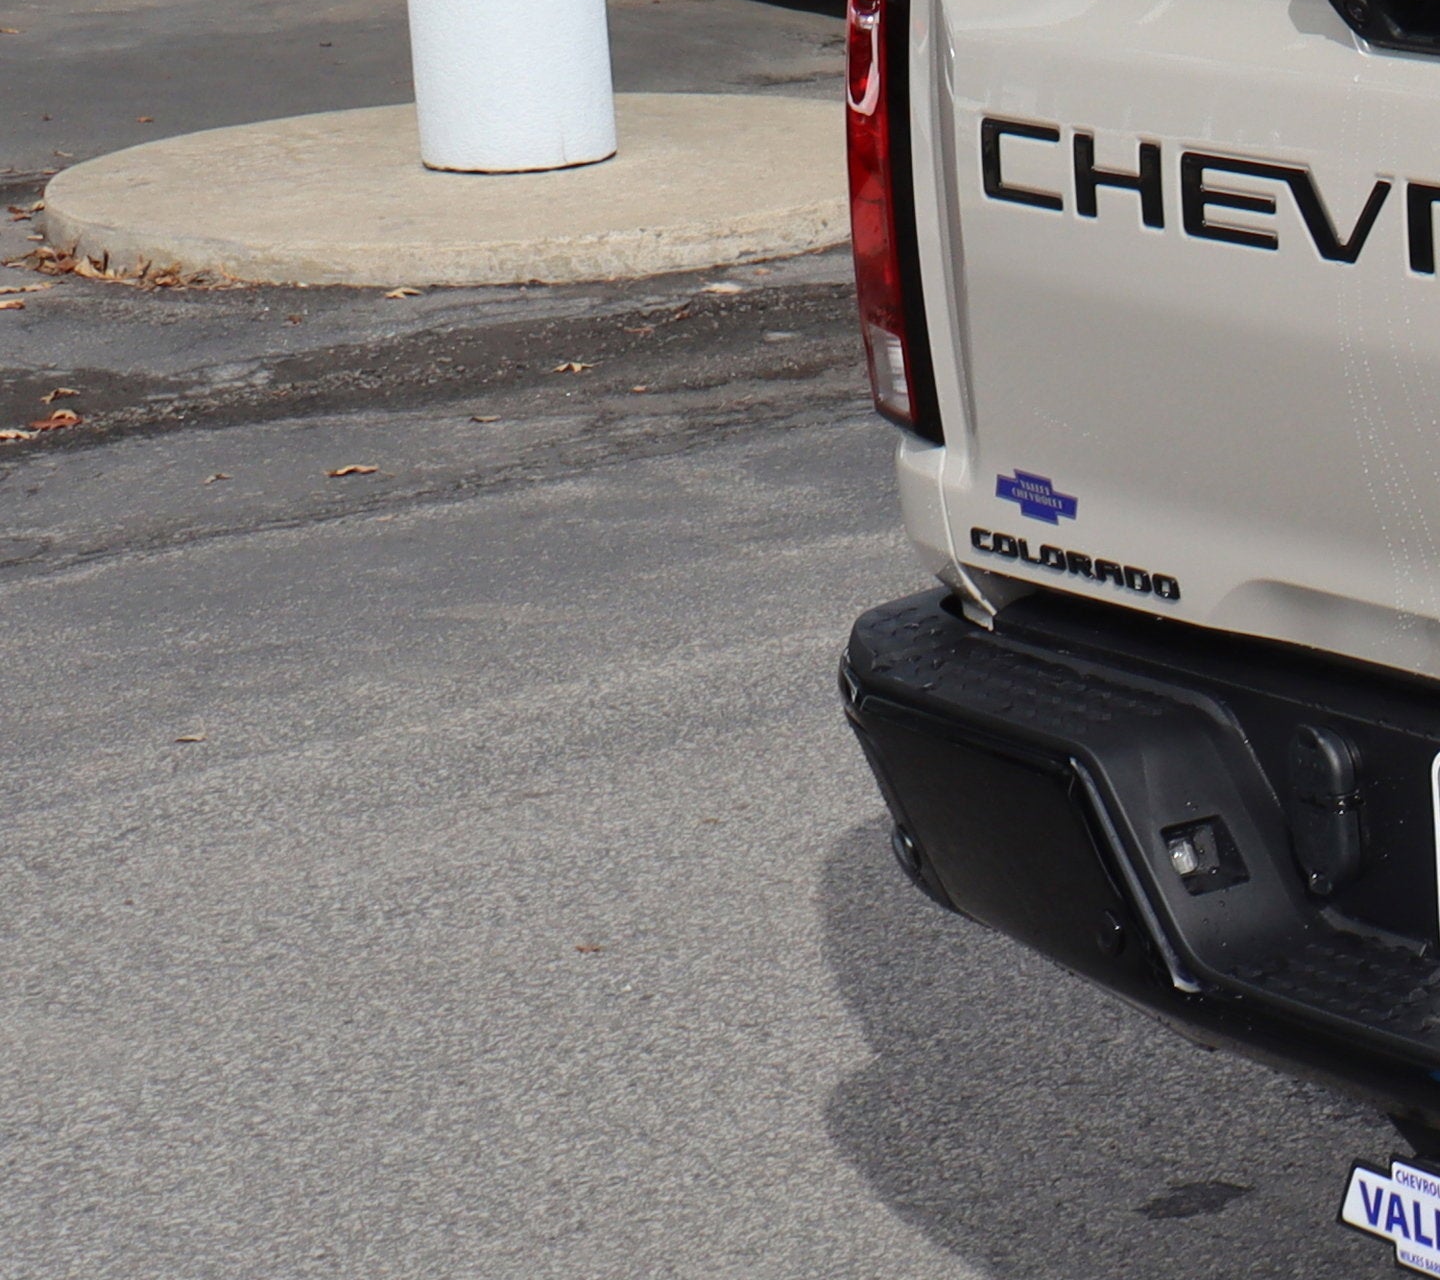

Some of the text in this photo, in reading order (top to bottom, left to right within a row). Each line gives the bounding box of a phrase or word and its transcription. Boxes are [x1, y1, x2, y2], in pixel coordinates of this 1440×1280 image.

[1011, 486, 1063, 510] CHEVROLET
[1019, 478, 1051, 497] VALLEY
[969, 526, 1181, 601] COLORADO
[1400, 1250, 1425, 1269] WILKES
